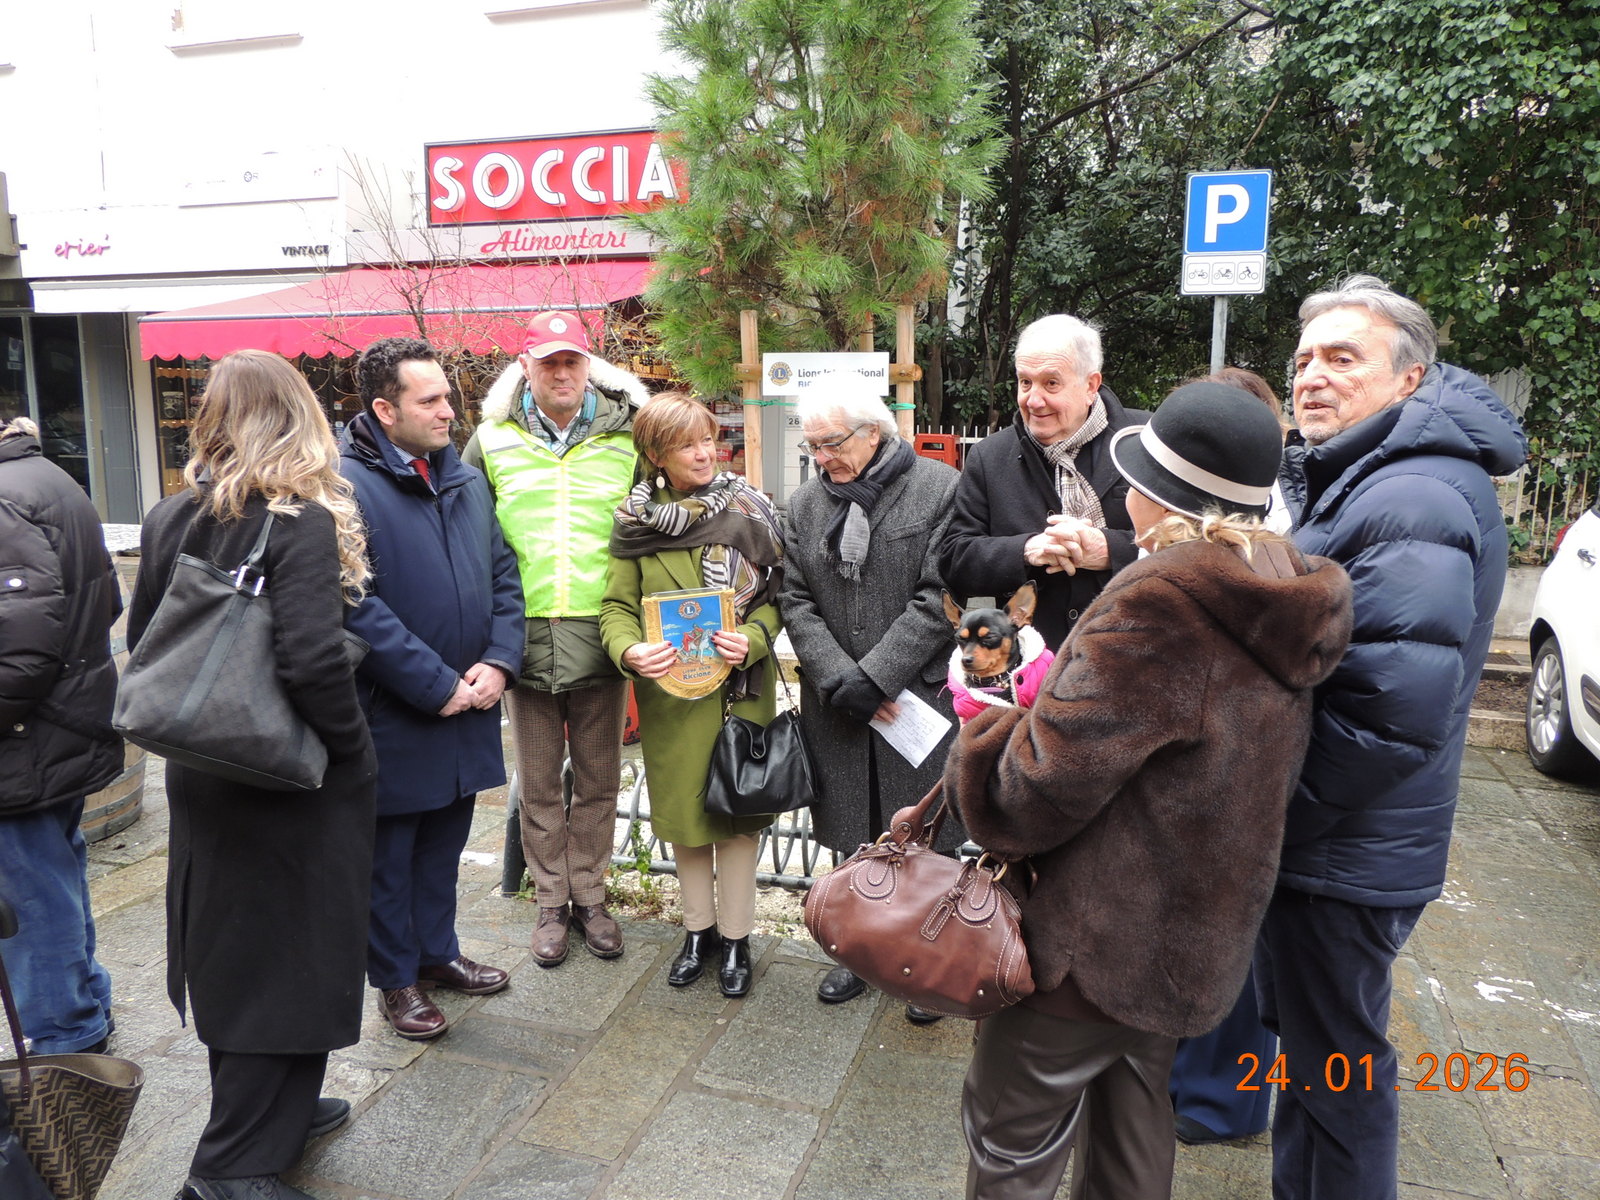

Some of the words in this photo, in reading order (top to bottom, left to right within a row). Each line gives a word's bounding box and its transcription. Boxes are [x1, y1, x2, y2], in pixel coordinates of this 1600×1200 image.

[432, 143, 681, 212] SOCCIA
[1203, 184, 1250, 243] P
[281, 244, 329, 257] VINTAGE
[480, 227, 627, 254] Alimentari
